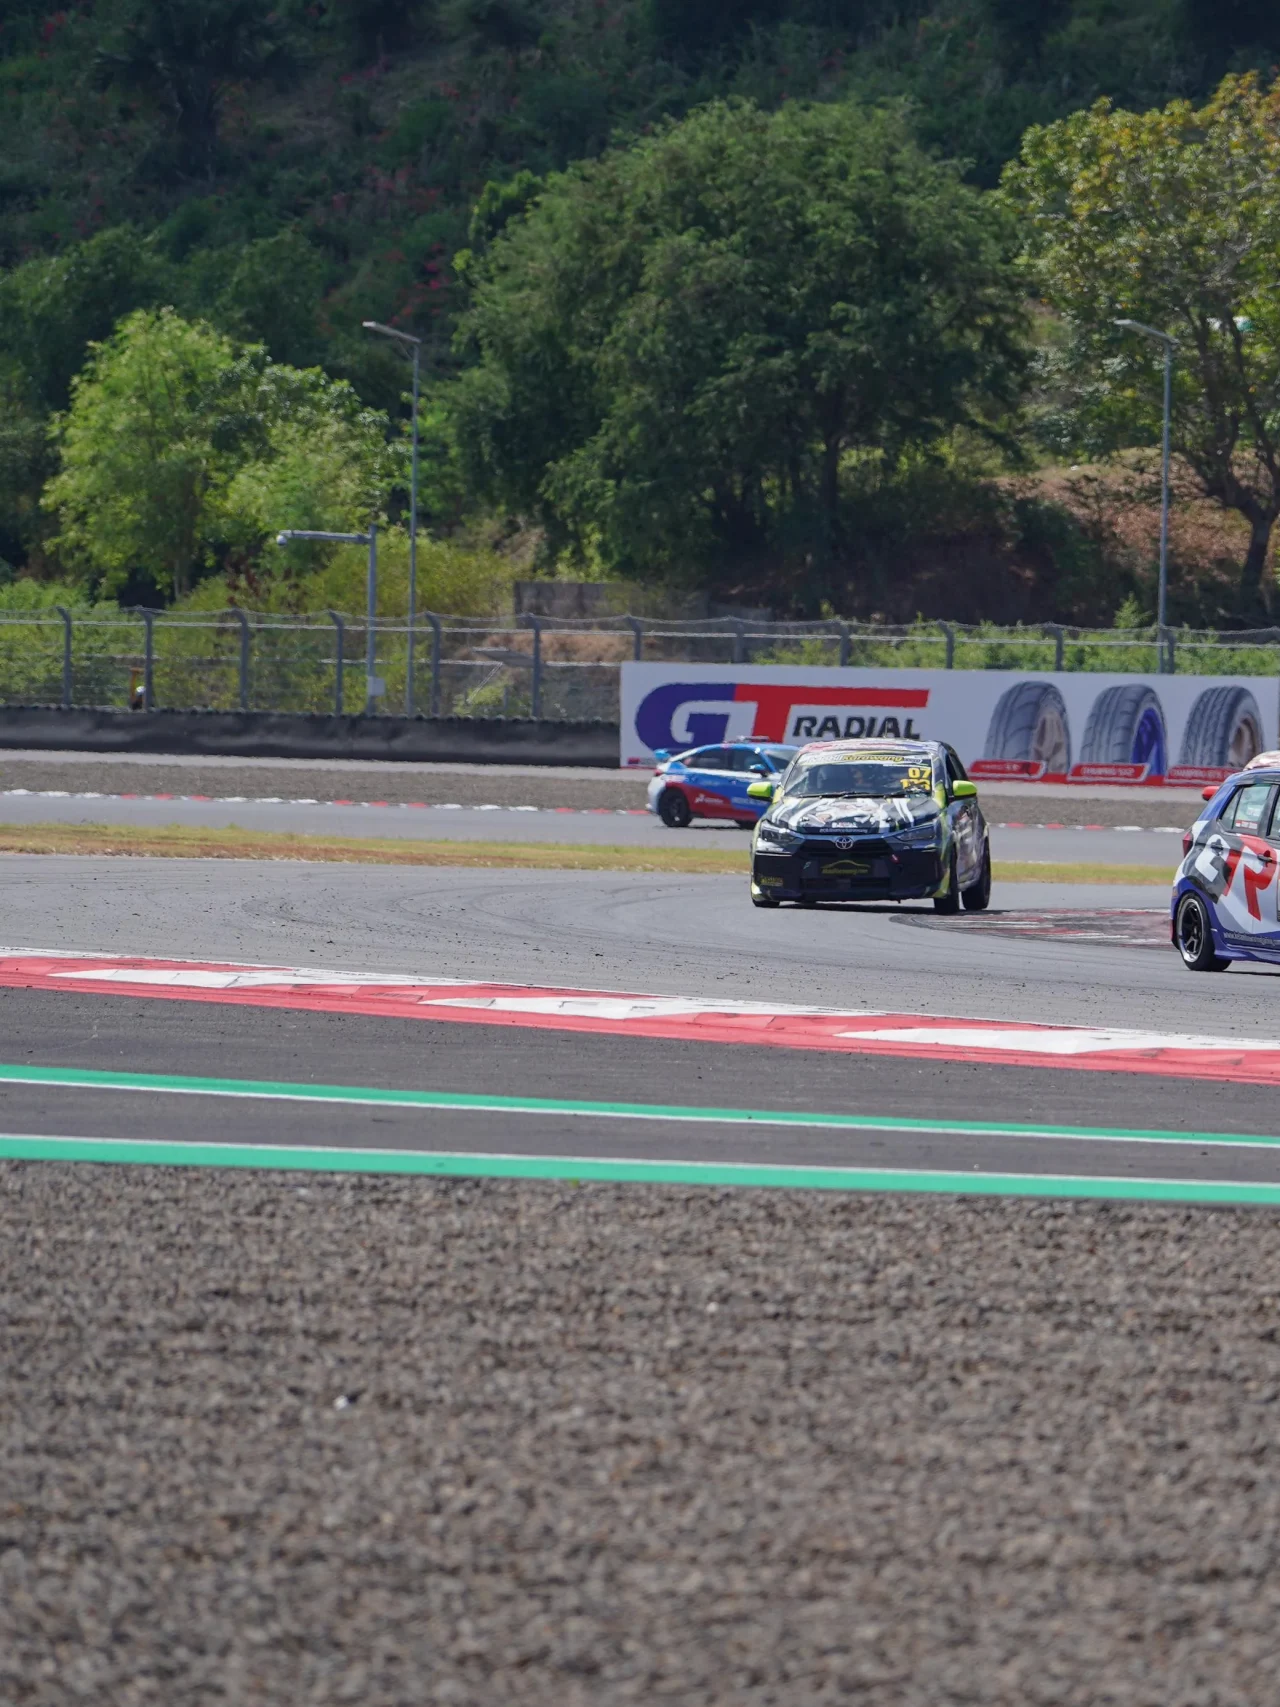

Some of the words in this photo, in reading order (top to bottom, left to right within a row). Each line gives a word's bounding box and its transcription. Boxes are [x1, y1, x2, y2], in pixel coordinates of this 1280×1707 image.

[635, 683, 930, 751] GT
[792, 715, 921, 740] RADIAL
[908, 767, 931, 779] 07
